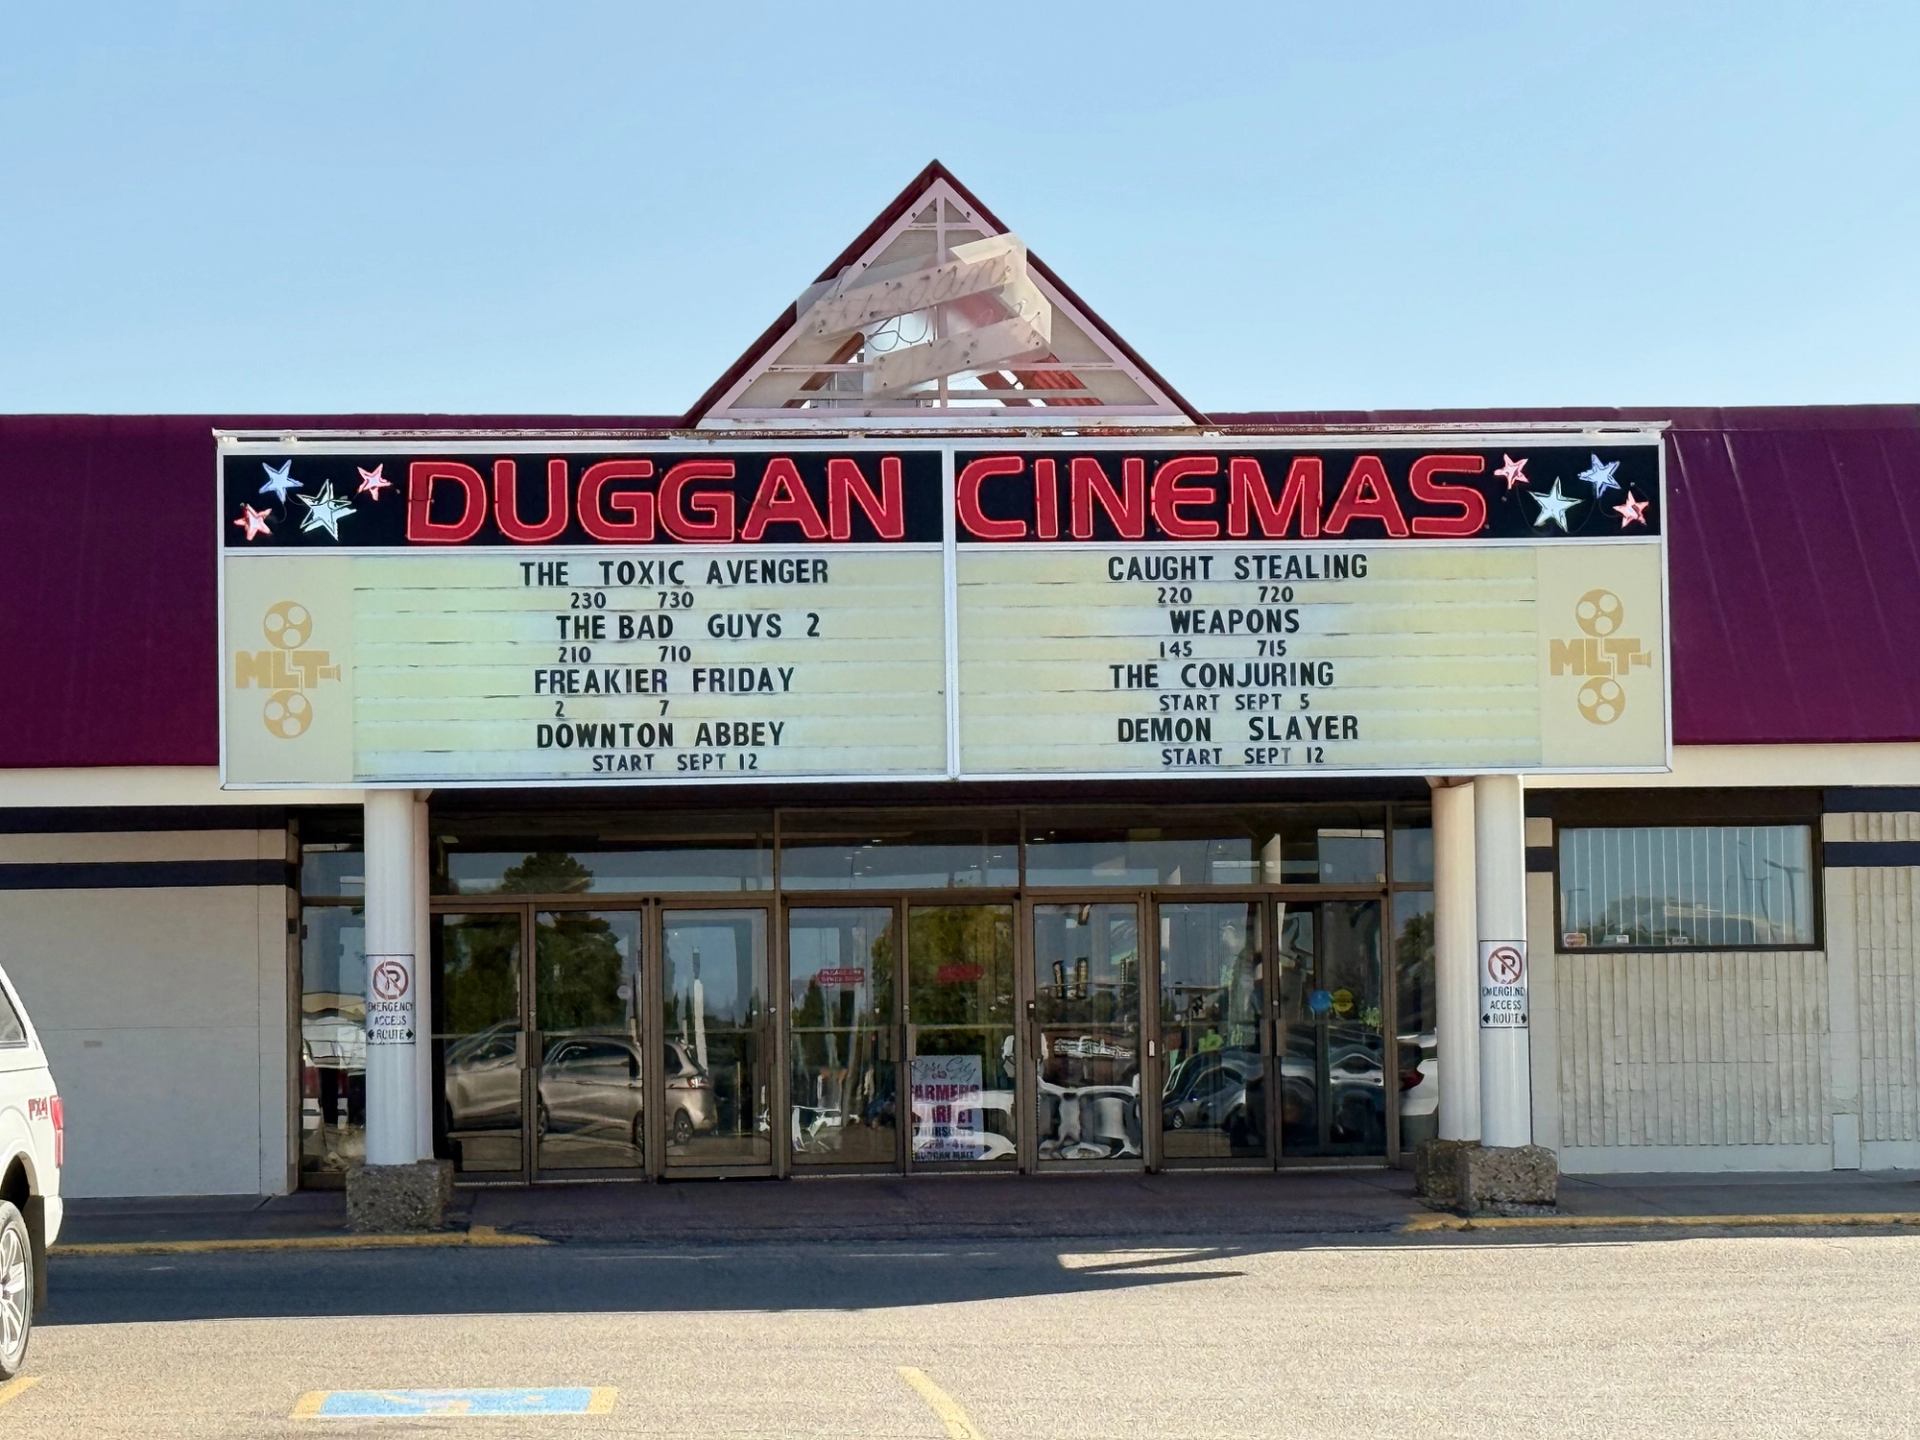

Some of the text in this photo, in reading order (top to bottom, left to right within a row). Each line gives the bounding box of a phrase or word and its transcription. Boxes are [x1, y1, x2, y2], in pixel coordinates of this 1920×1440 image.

[405, 453, 1488, 544] DUGGAN CINEMAS
[519, 558, 828, 587] THE TOXIC AVENGER
[1108, 553, 1368, 581] CAUGHT STEALING
[570, 591, 694, 610] 230 730
[1157, 585, 1294, 604] 220 720
[555, 612, 820, 640] THE BAD GUYS 2
[1169, 608, 1300, 634] WEAPONS
[558, 645, 692, 664] 210 710
[1159, 639, 1287, 658] 145 715
[1549, 638, 1641, 676] MLT
[235, 650, 330, 689] MLT
[1109, 661, 1334, 689] THE CONJURING
[534, 666, 794, 694] FREAKIER FRIDAY
[555, 699, 670, 718] 2 7
[1159, 693, 1310, 712] START SEPT 5
[537, 721, 785, 749] DOWNTON ABBEY
[1117, 715, 1358, 743] DEMON SLAYER
[592, 753, 758, 772] START SEPT 12
[1161, 746, 1324, 766] START SEPT 12
[1490, 999, 1522, 1010] ACCESS
[374, 1015, 407, 1026] ACCESS
[1493, 1013, 1520, 1024] ROUTE
[376, 1028, 406, 1040] ROUTE
[911, 1083, 980, 1102] ARMERS
